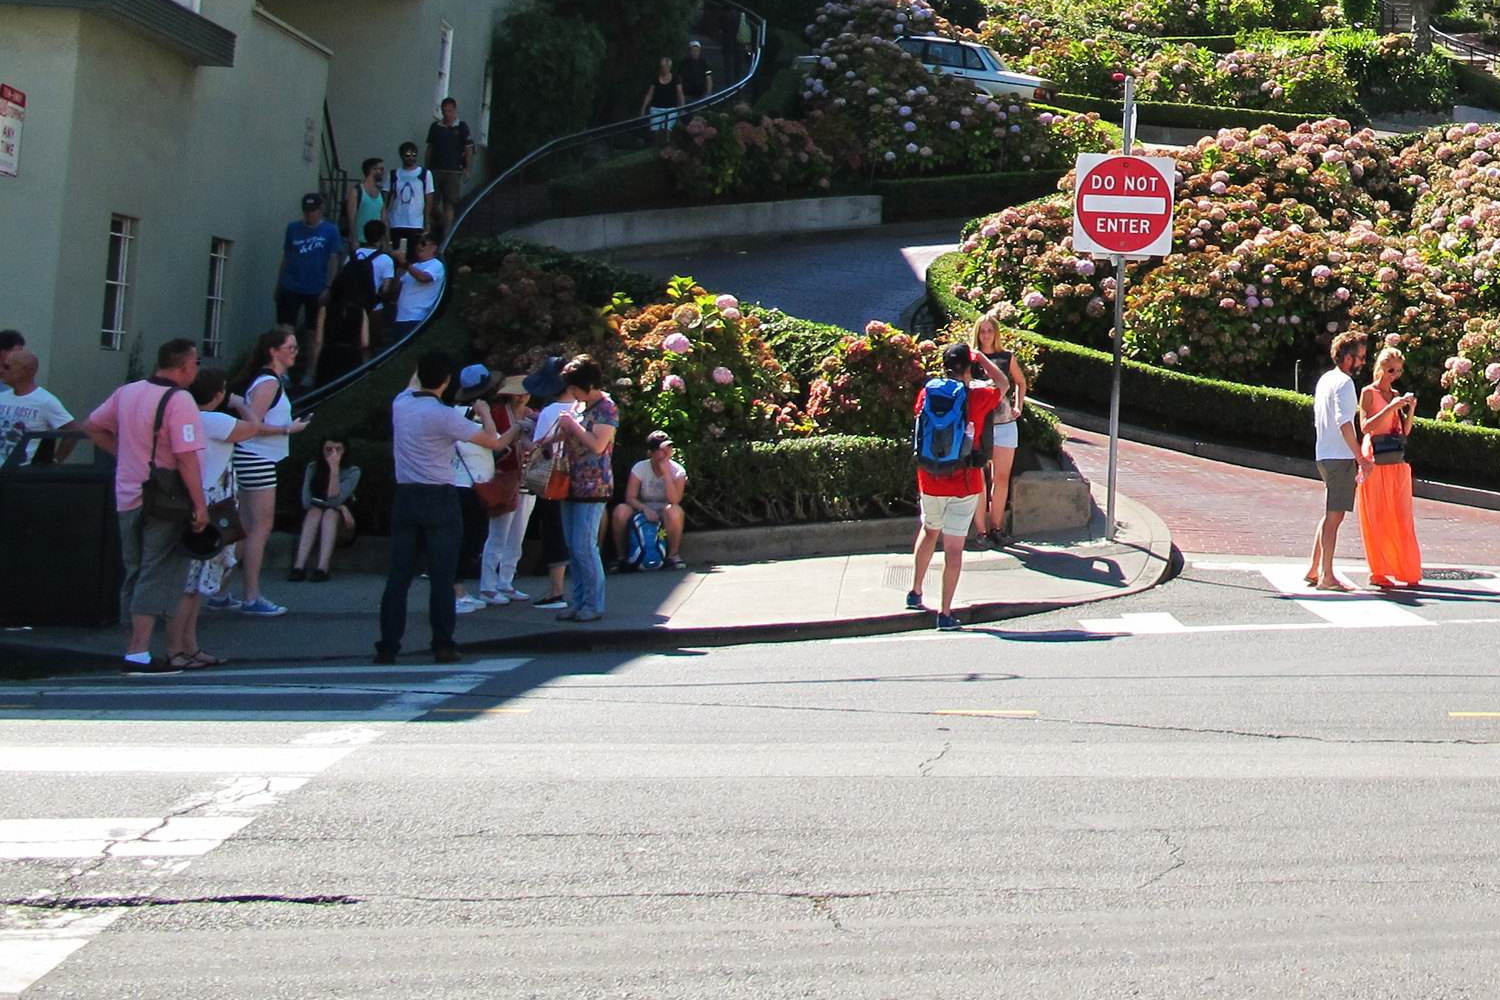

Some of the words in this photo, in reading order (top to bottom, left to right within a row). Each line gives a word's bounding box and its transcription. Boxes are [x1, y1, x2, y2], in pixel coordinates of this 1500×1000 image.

[1091, 174, 1115, 190] DO
[1124, 176, 1159, 191] NOT
[1096, 217, 1151, 234] ENTER
